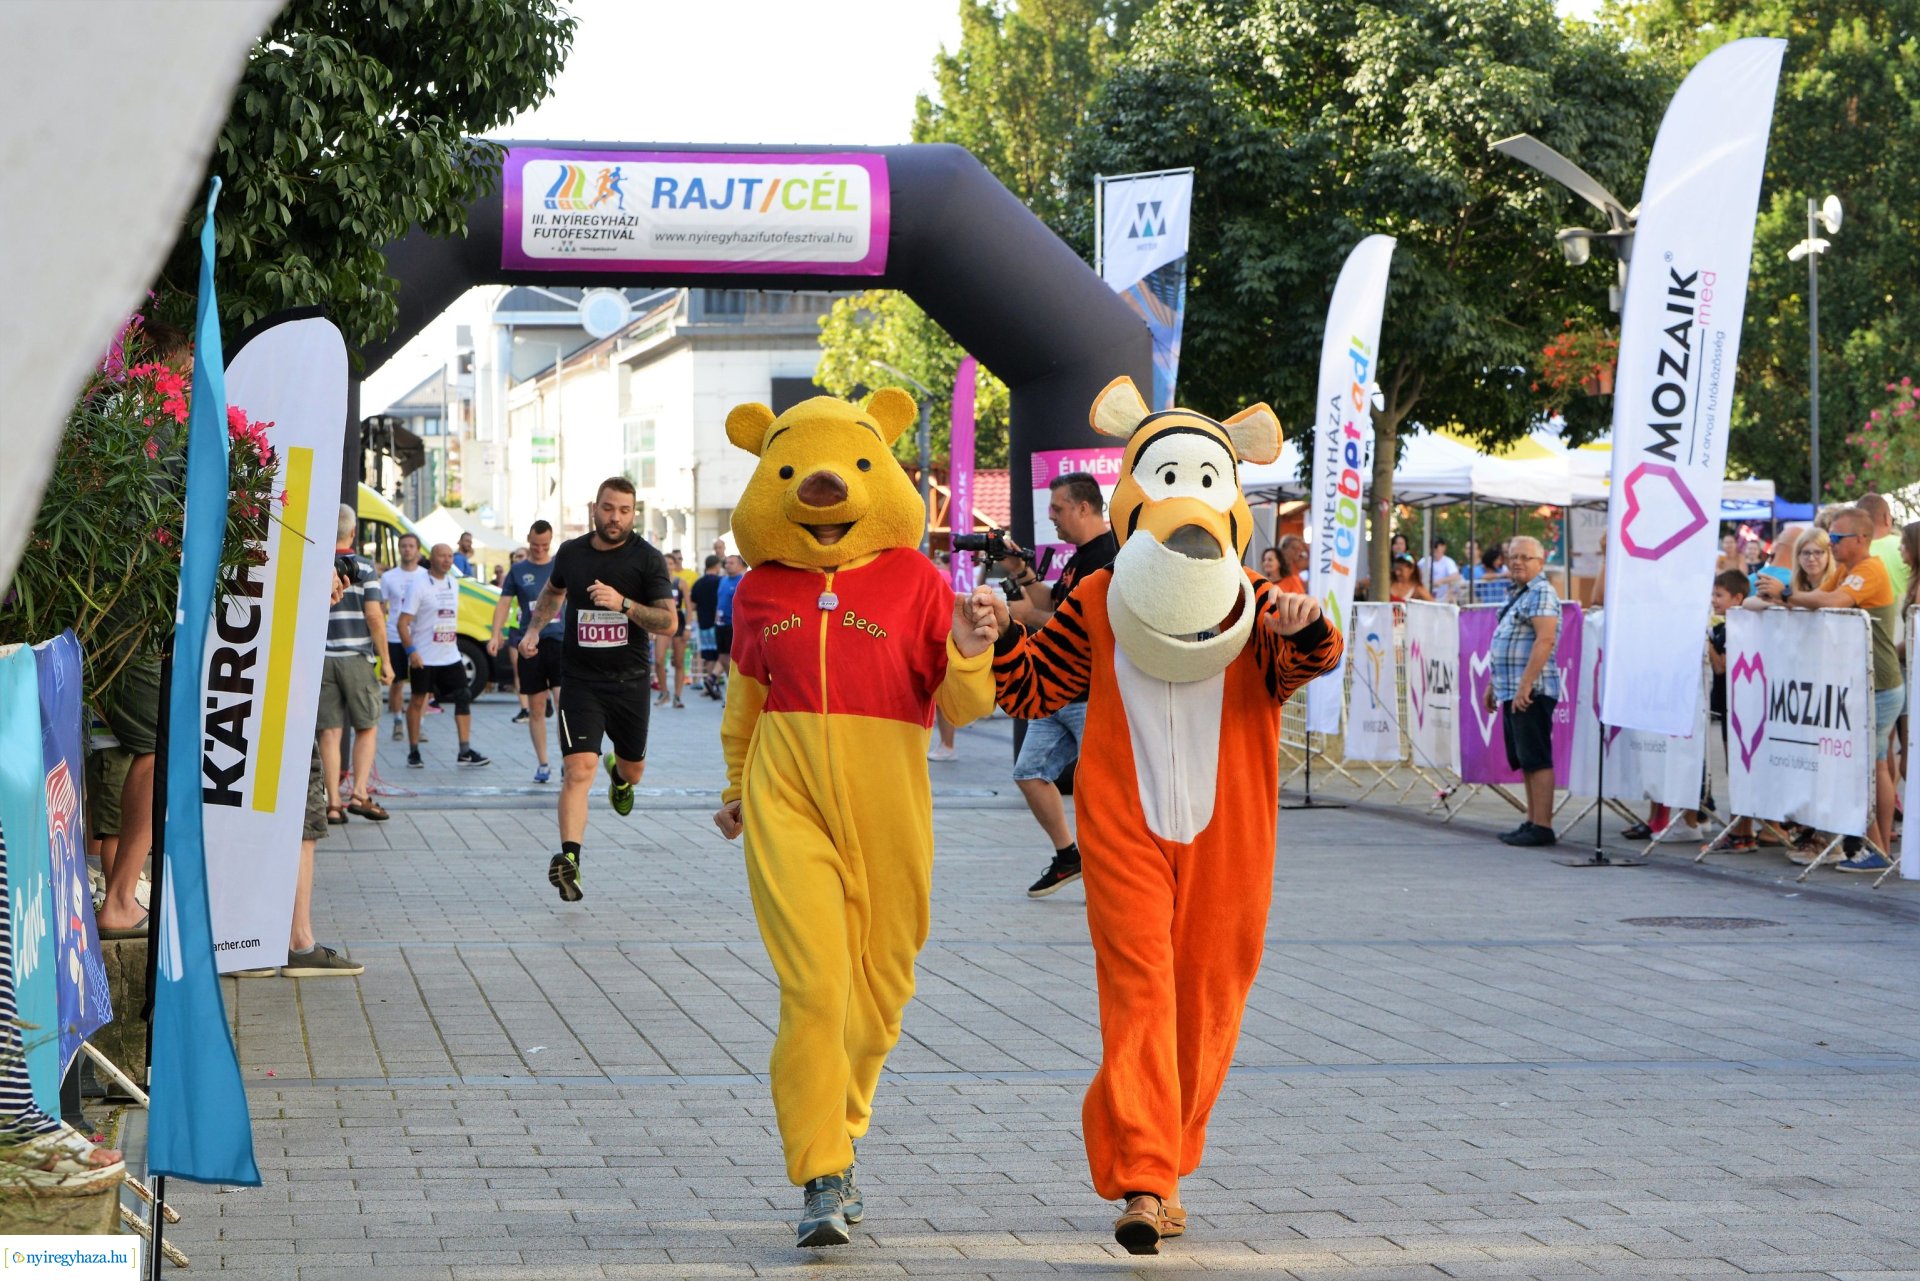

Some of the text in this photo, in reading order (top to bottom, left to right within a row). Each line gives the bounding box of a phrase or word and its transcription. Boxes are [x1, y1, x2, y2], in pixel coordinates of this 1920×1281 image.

[651, 172, 859, 213] RAJT/CÉL
[532, 212, 639, 227] III. NYÍREGYHÁZI
[534, 226, 635, 240] FUTÓFESZTIVÁL
[1699, 270, 1717, 325] med
[1349, 335, 1371, 413] ad!
[1643, 266, 1698, 462] MOZAIK
[958, 471, 968, 568] MZAIK
[202, 445, 276, 808] KÄRCH
[580, 625, 627, 640] 10110
[843, 611, 888, 639] Bear
